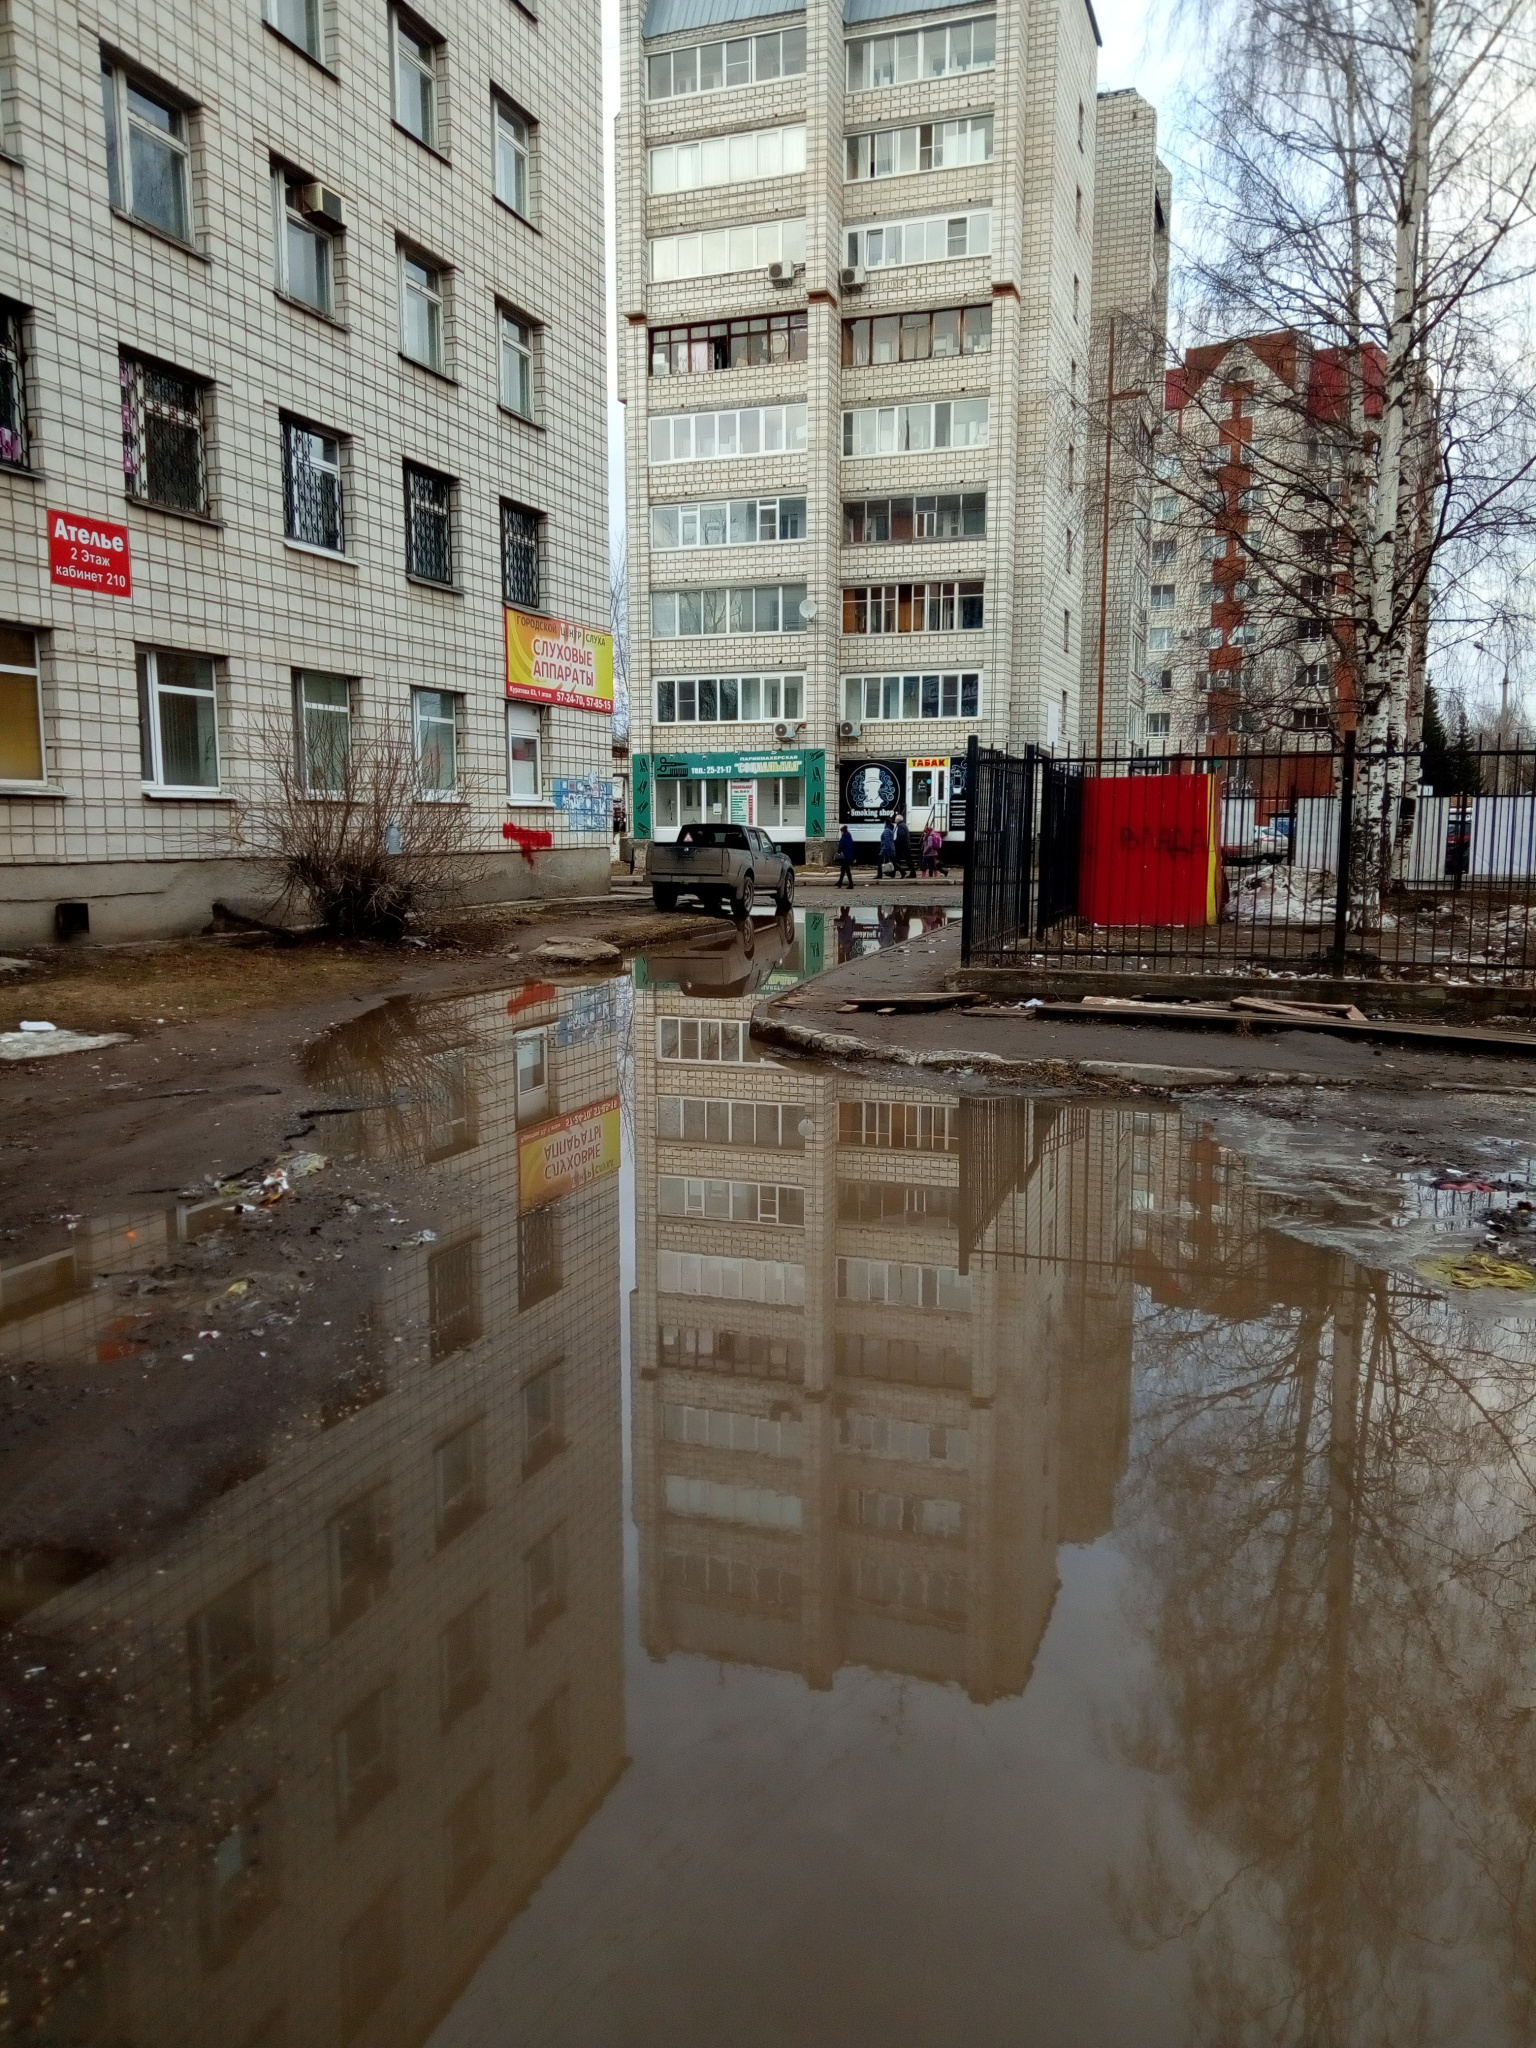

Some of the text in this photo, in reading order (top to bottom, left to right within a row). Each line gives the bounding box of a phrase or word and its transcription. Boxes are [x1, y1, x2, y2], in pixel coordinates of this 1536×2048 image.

[54, 518, 124, 552] Ателье
[71, 547, 110, 567] 2 Этаж
[56, 565, 126, 588] кабинет 210
[516, 615, 606, 647] ГОРОДСКОЙ ЦНР СЛУХА
[533, 638, 593, 667] СЛУХОВЫЕ
[533, 660, 594, 687] АППАРАТЫ
[556, 691, 585, 707] 57-24-70,
[586, 697, 611, 711] 57-85-15
[707, 765, 732, 774] 25-21-17
[911, 759, 946, 767] ТАБАК
[851, 809, 895, 818] Smoking shop
